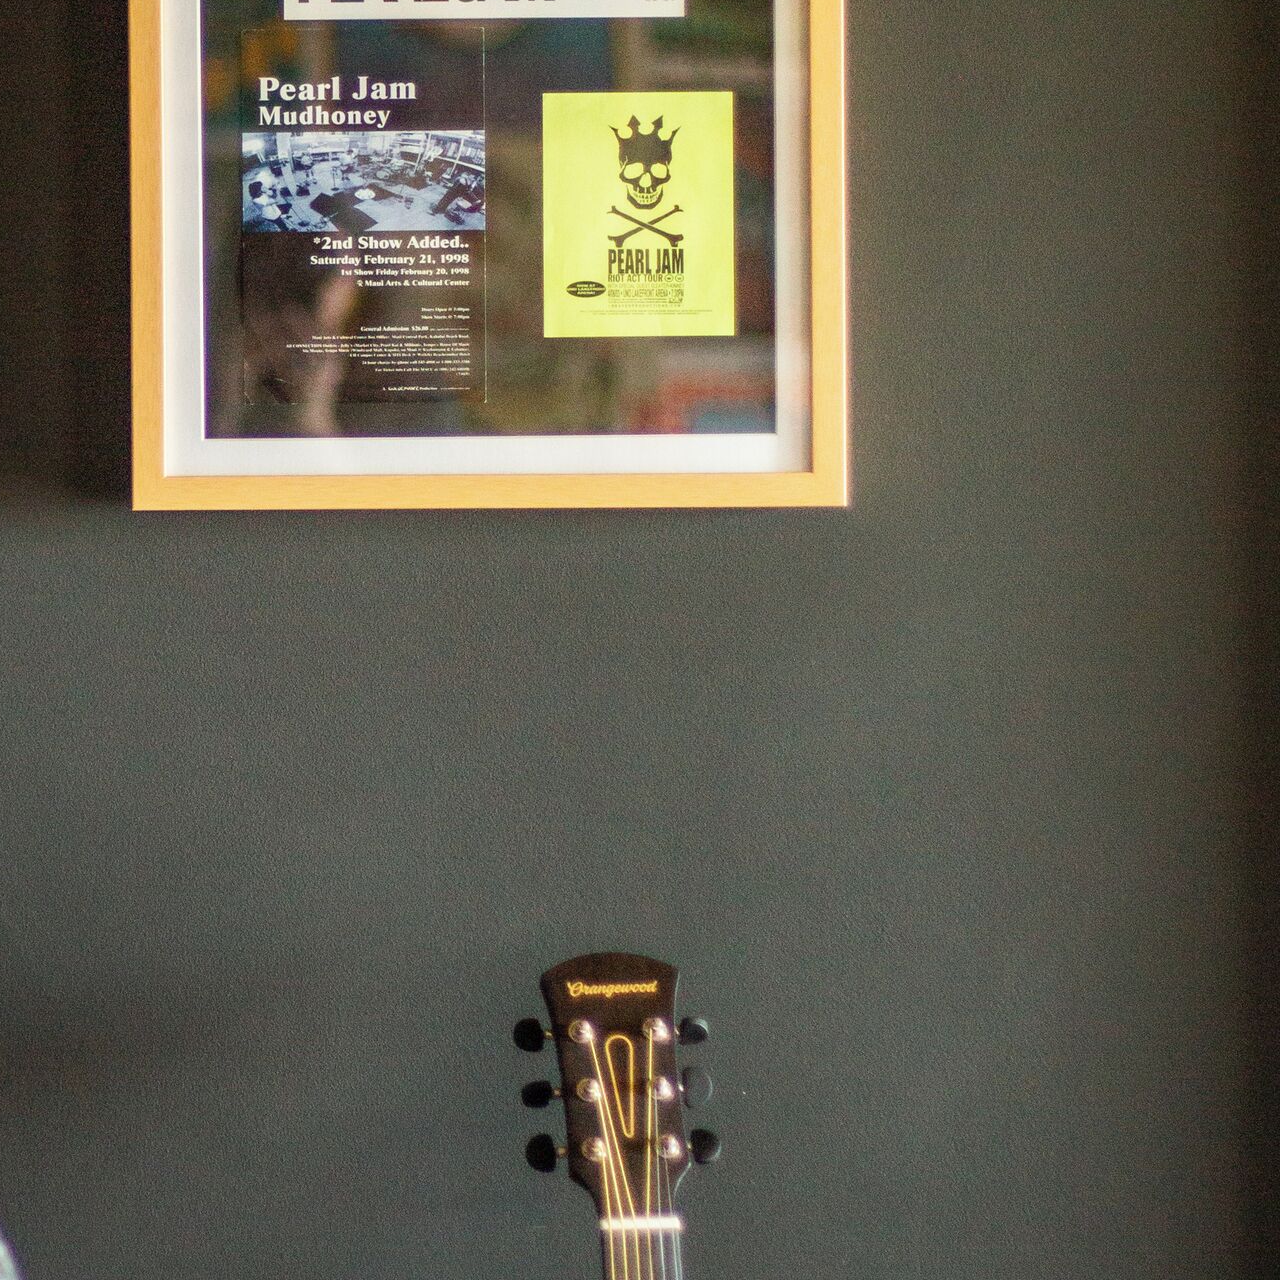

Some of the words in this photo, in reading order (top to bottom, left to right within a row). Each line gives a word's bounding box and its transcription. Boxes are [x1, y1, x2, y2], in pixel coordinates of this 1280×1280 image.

[258, 76, 341, 101] Pearl
[352, 76, 417, 100] Jam
[258, 105, 391, 129] Mudhoney
[358, 236, 402, 249] Show
[310, 255, 361, 266] Saturday
[364, 255, 416, 266] February
[419, 254, 436, 265] 21,
[440, 254, 470, 264] 1998
[608, 249, 652, 274] PEARL
[655, 248, 684, 274] JAM
[375, 268, 400, 276] Friday
[400, 268, 434, 276] February
[450, 267, 470, 275] 1998
[608, 274, 624, 282] RIOT
[626, 274, 641, 282] ACT
[644, 274, 663, 282] TOUR
[365, 279, 384, 287] Maui
[386, 279, 402, 287] Arts
[403, 279, 411, 287] &
[411, 279, 443, 287] Cultural
[567, 980, 657, 998] Orangewood
